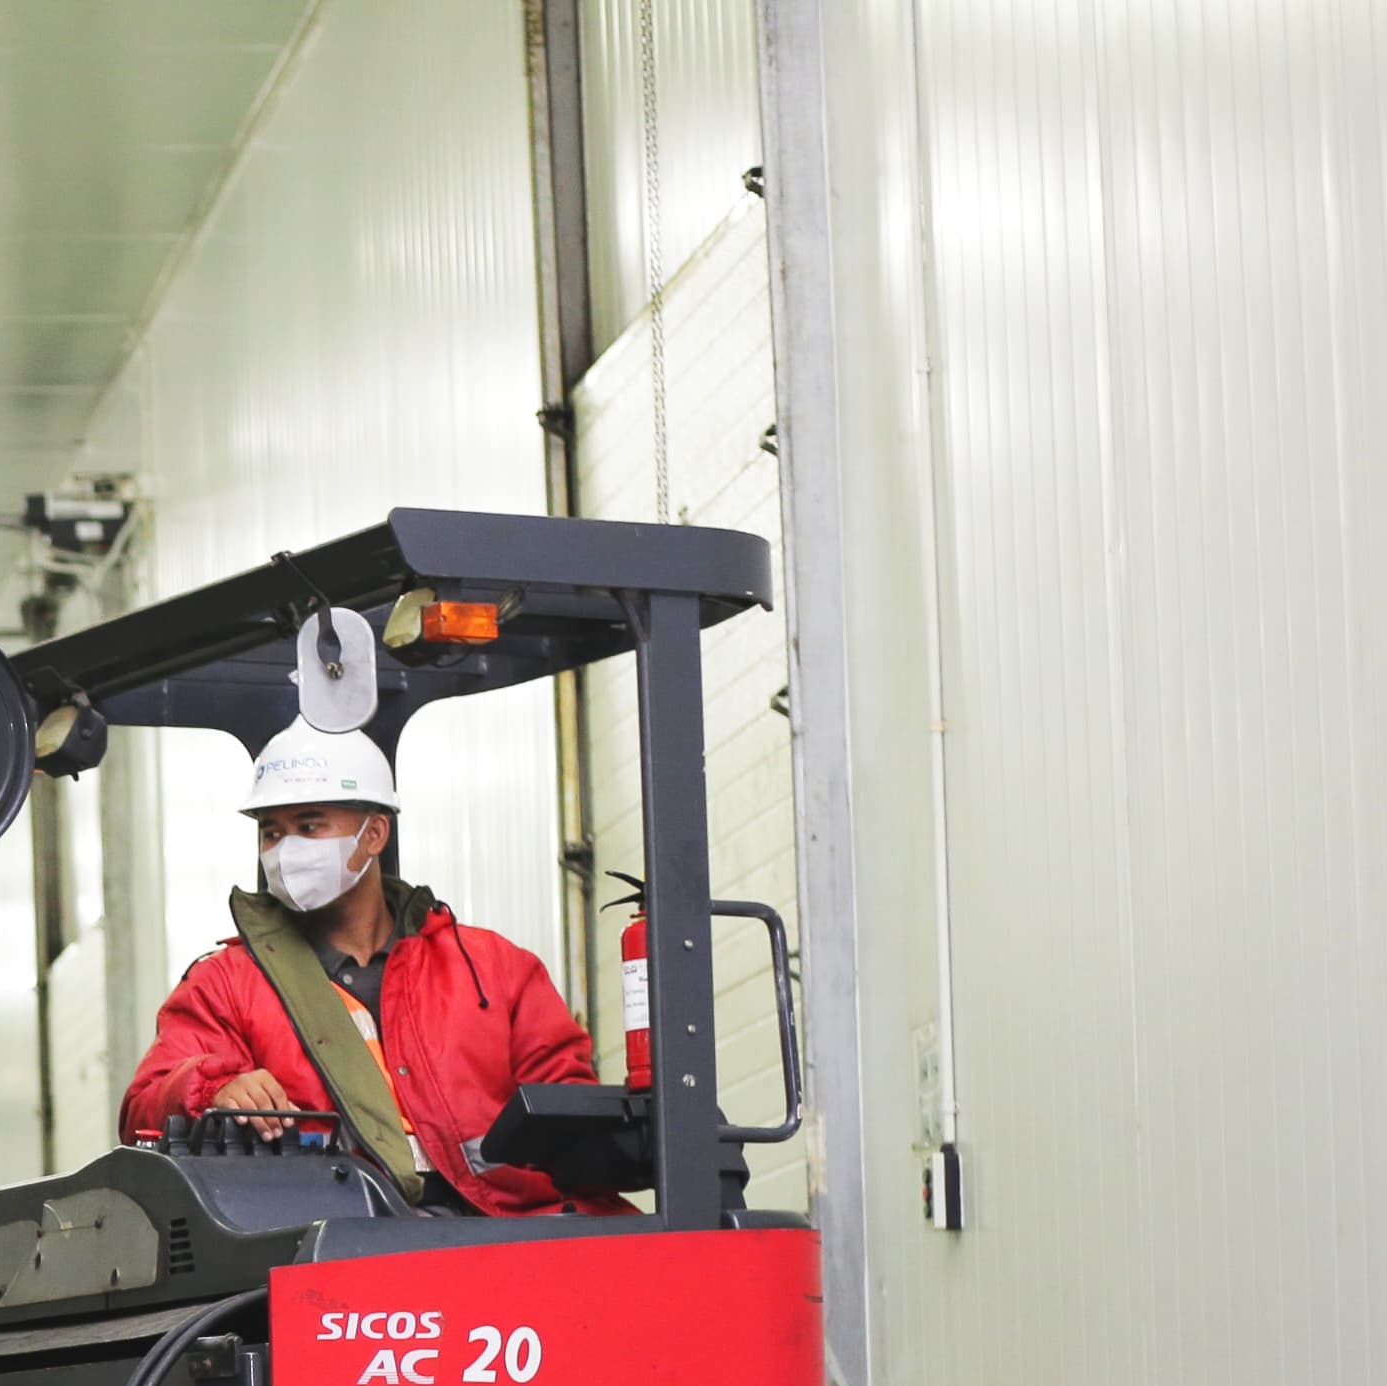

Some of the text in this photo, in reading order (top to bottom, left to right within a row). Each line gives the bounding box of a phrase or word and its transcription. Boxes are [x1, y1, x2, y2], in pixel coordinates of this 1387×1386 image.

[316, 1311, 443, 1341] SICOS
[356, 1325, 543, 1386] AC 20
